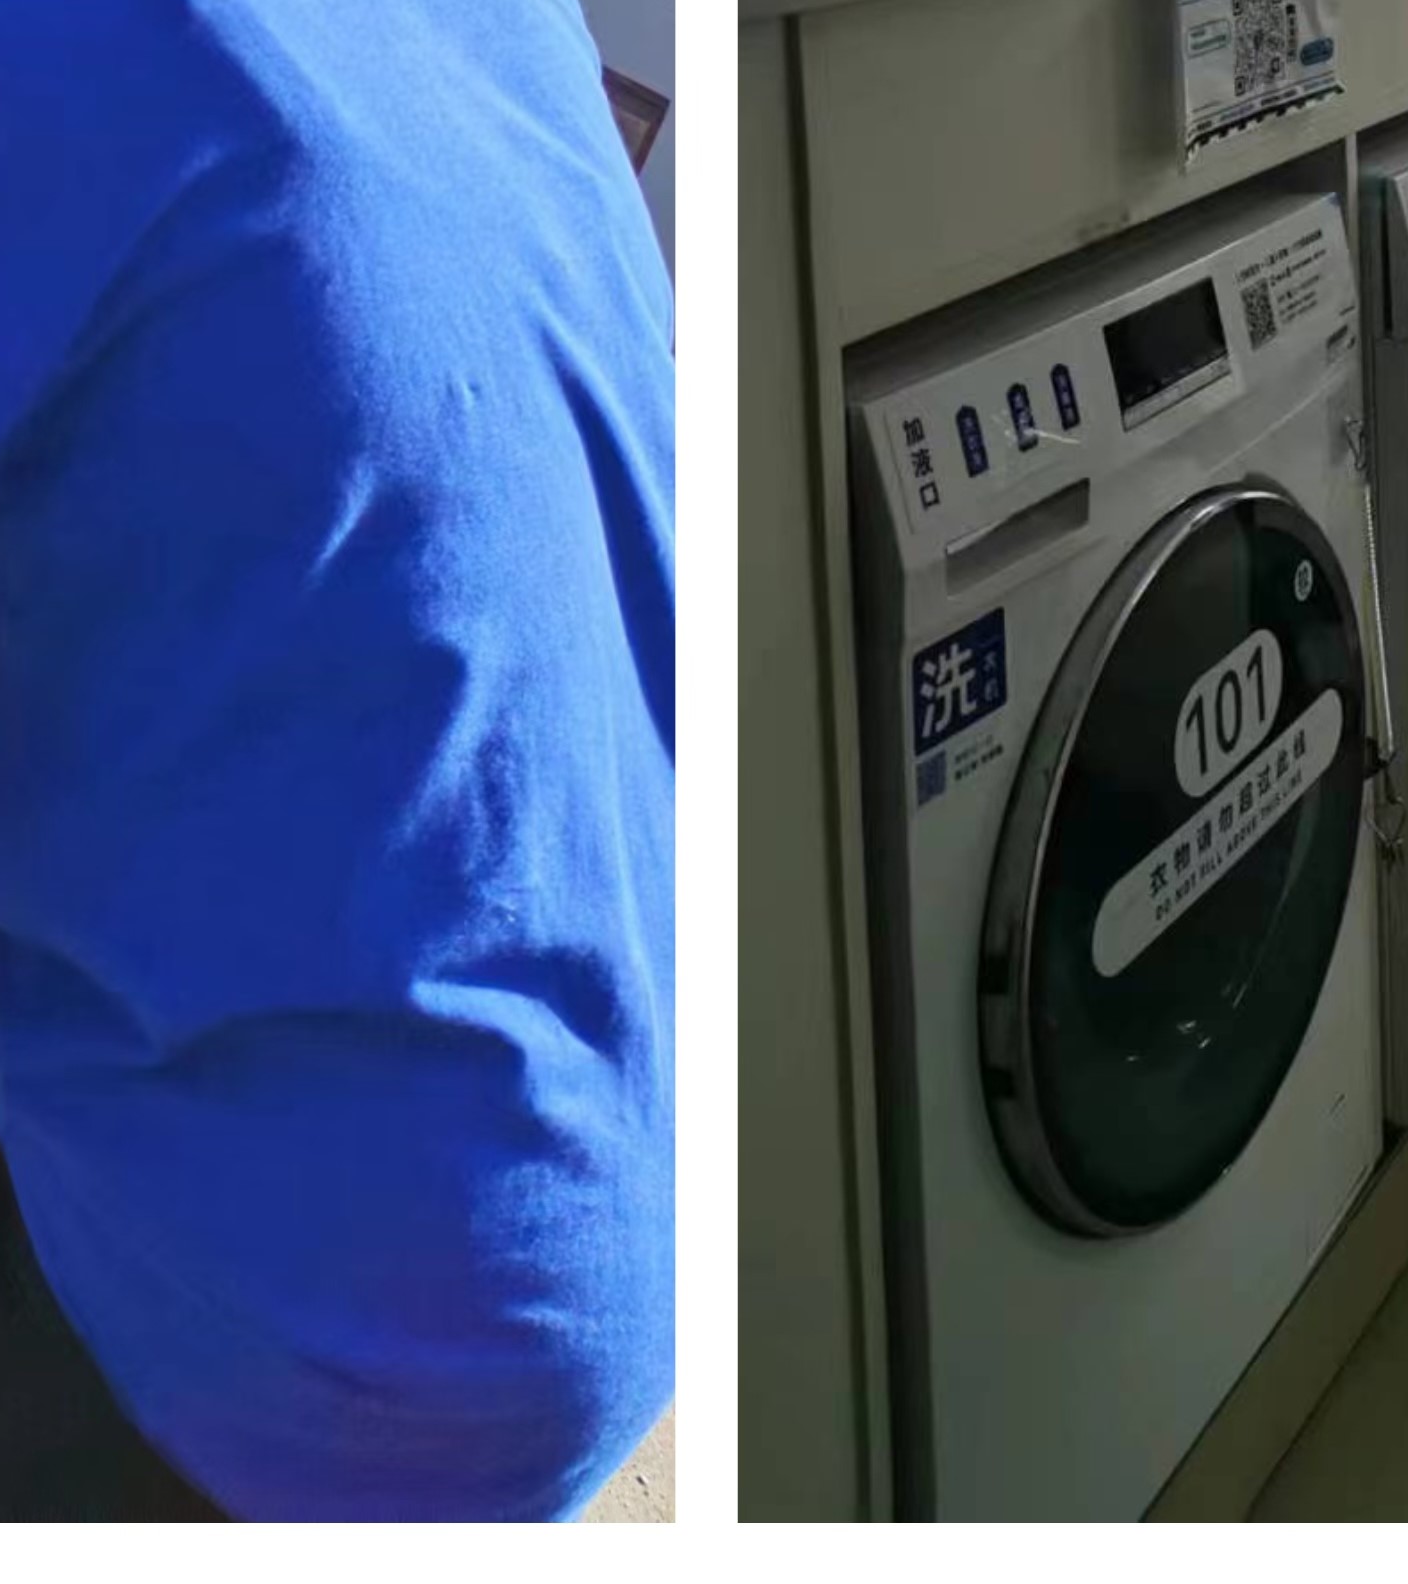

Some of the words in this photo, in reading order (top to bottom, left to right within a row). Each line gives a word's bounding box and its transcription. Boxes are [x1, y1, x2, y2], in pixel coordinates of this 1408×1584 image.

[903, 417, 940, 511] 加液口
[920, 643, 977, 738] 洗
[1184, 645, 1266, 776] 101
